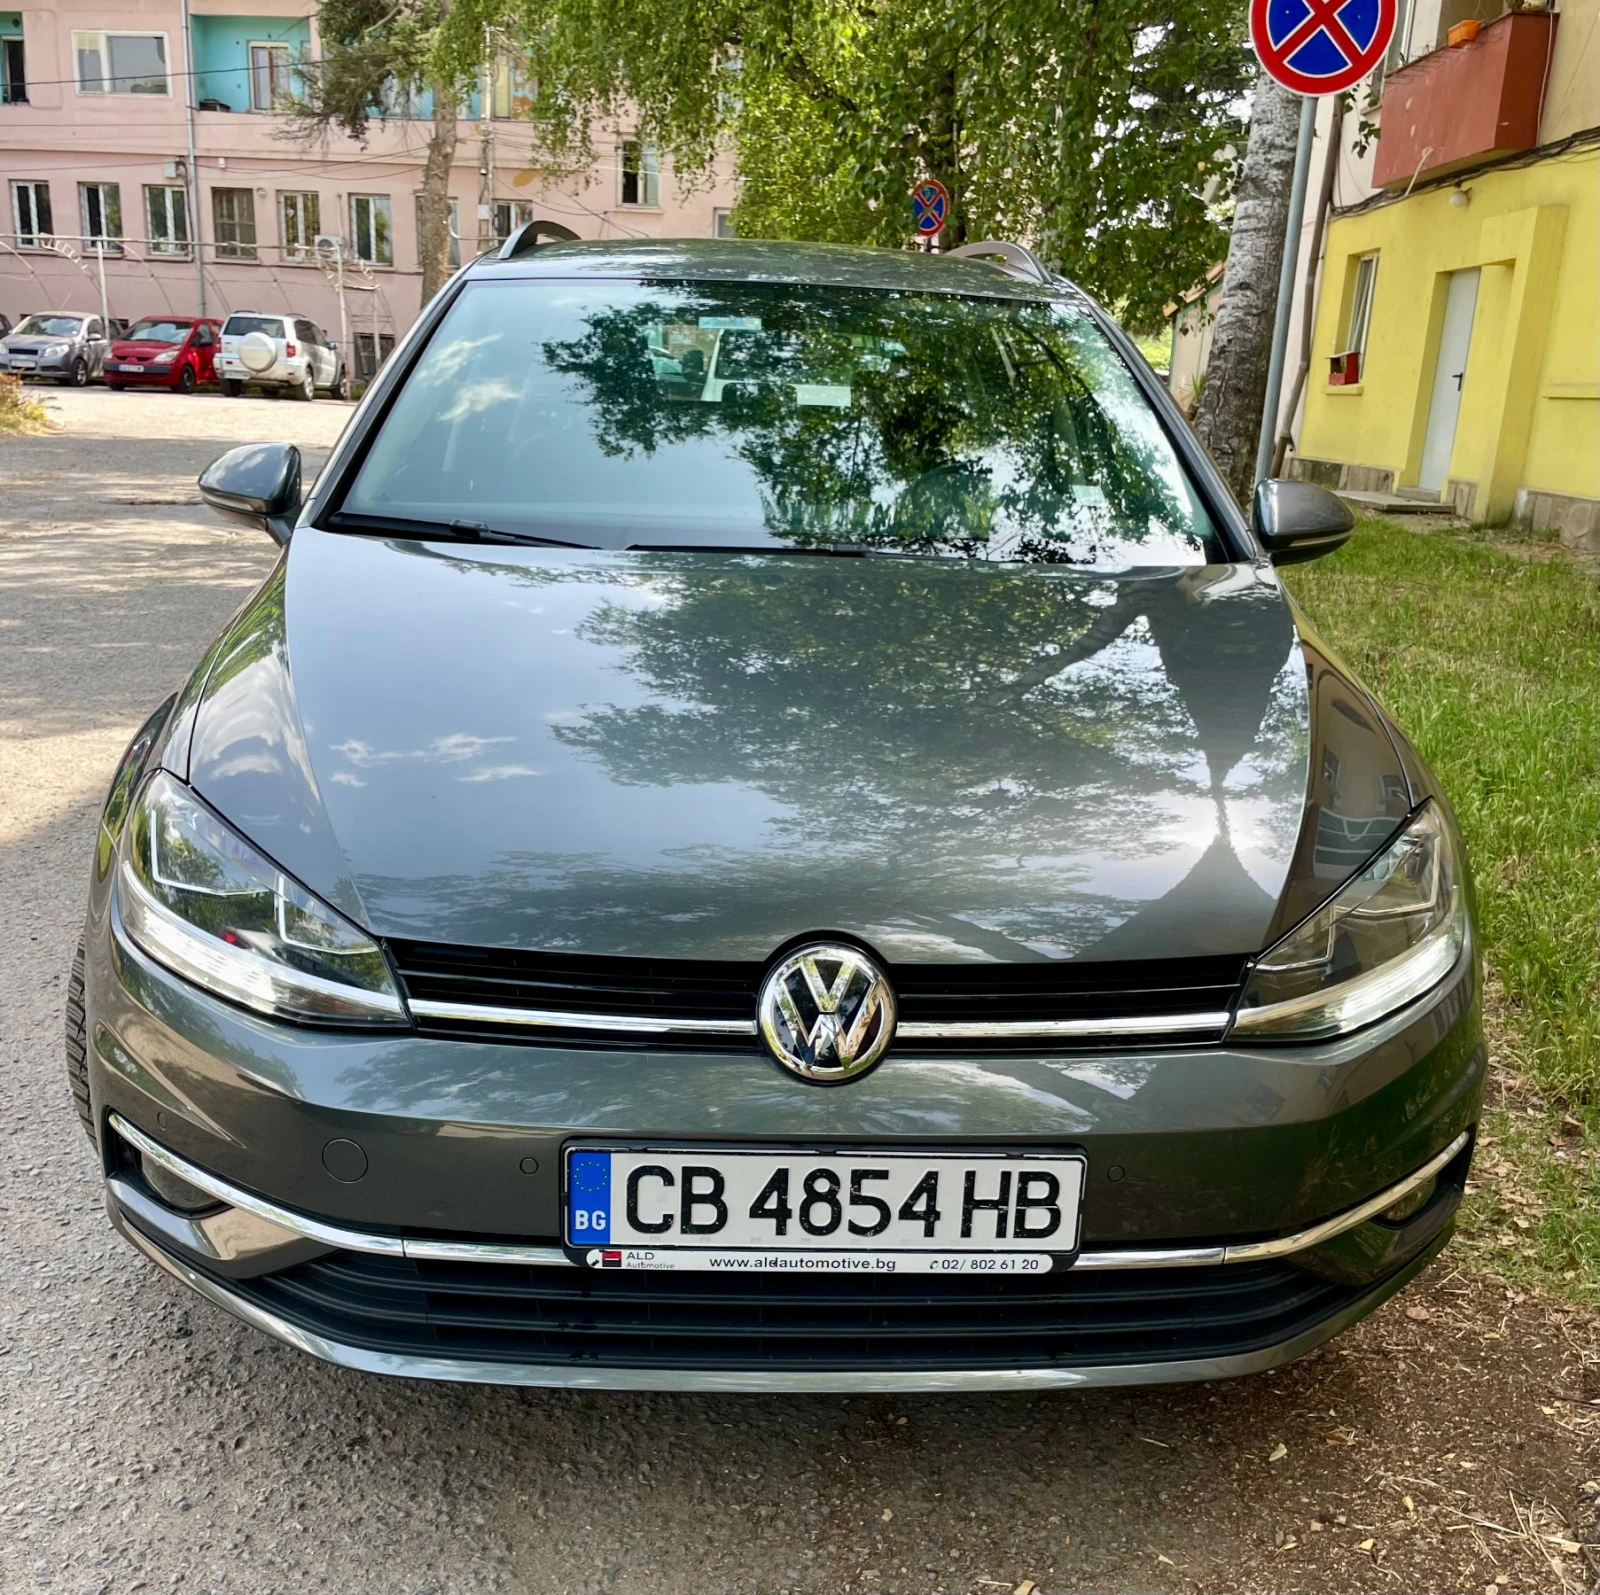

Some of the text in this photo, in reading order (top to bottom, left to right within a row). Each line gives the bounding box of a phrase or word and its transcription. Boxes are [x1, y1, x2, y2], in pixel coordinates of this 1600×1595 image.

[626, 1164, 1061, 1239] CB 4854 HB
[574, 1210, 607, 1231] BG
[626, 1251, 655, 1261] ALD
[626, 1261, 676, 1270] Automotive
[709, 1256, 897, 1272] www.aldautomotive.bg
[970, 1259, 996, 1270] 802
[1000, 1259, 1016, 1270] 61
[1021, 1259, 1039, 1270] 20
